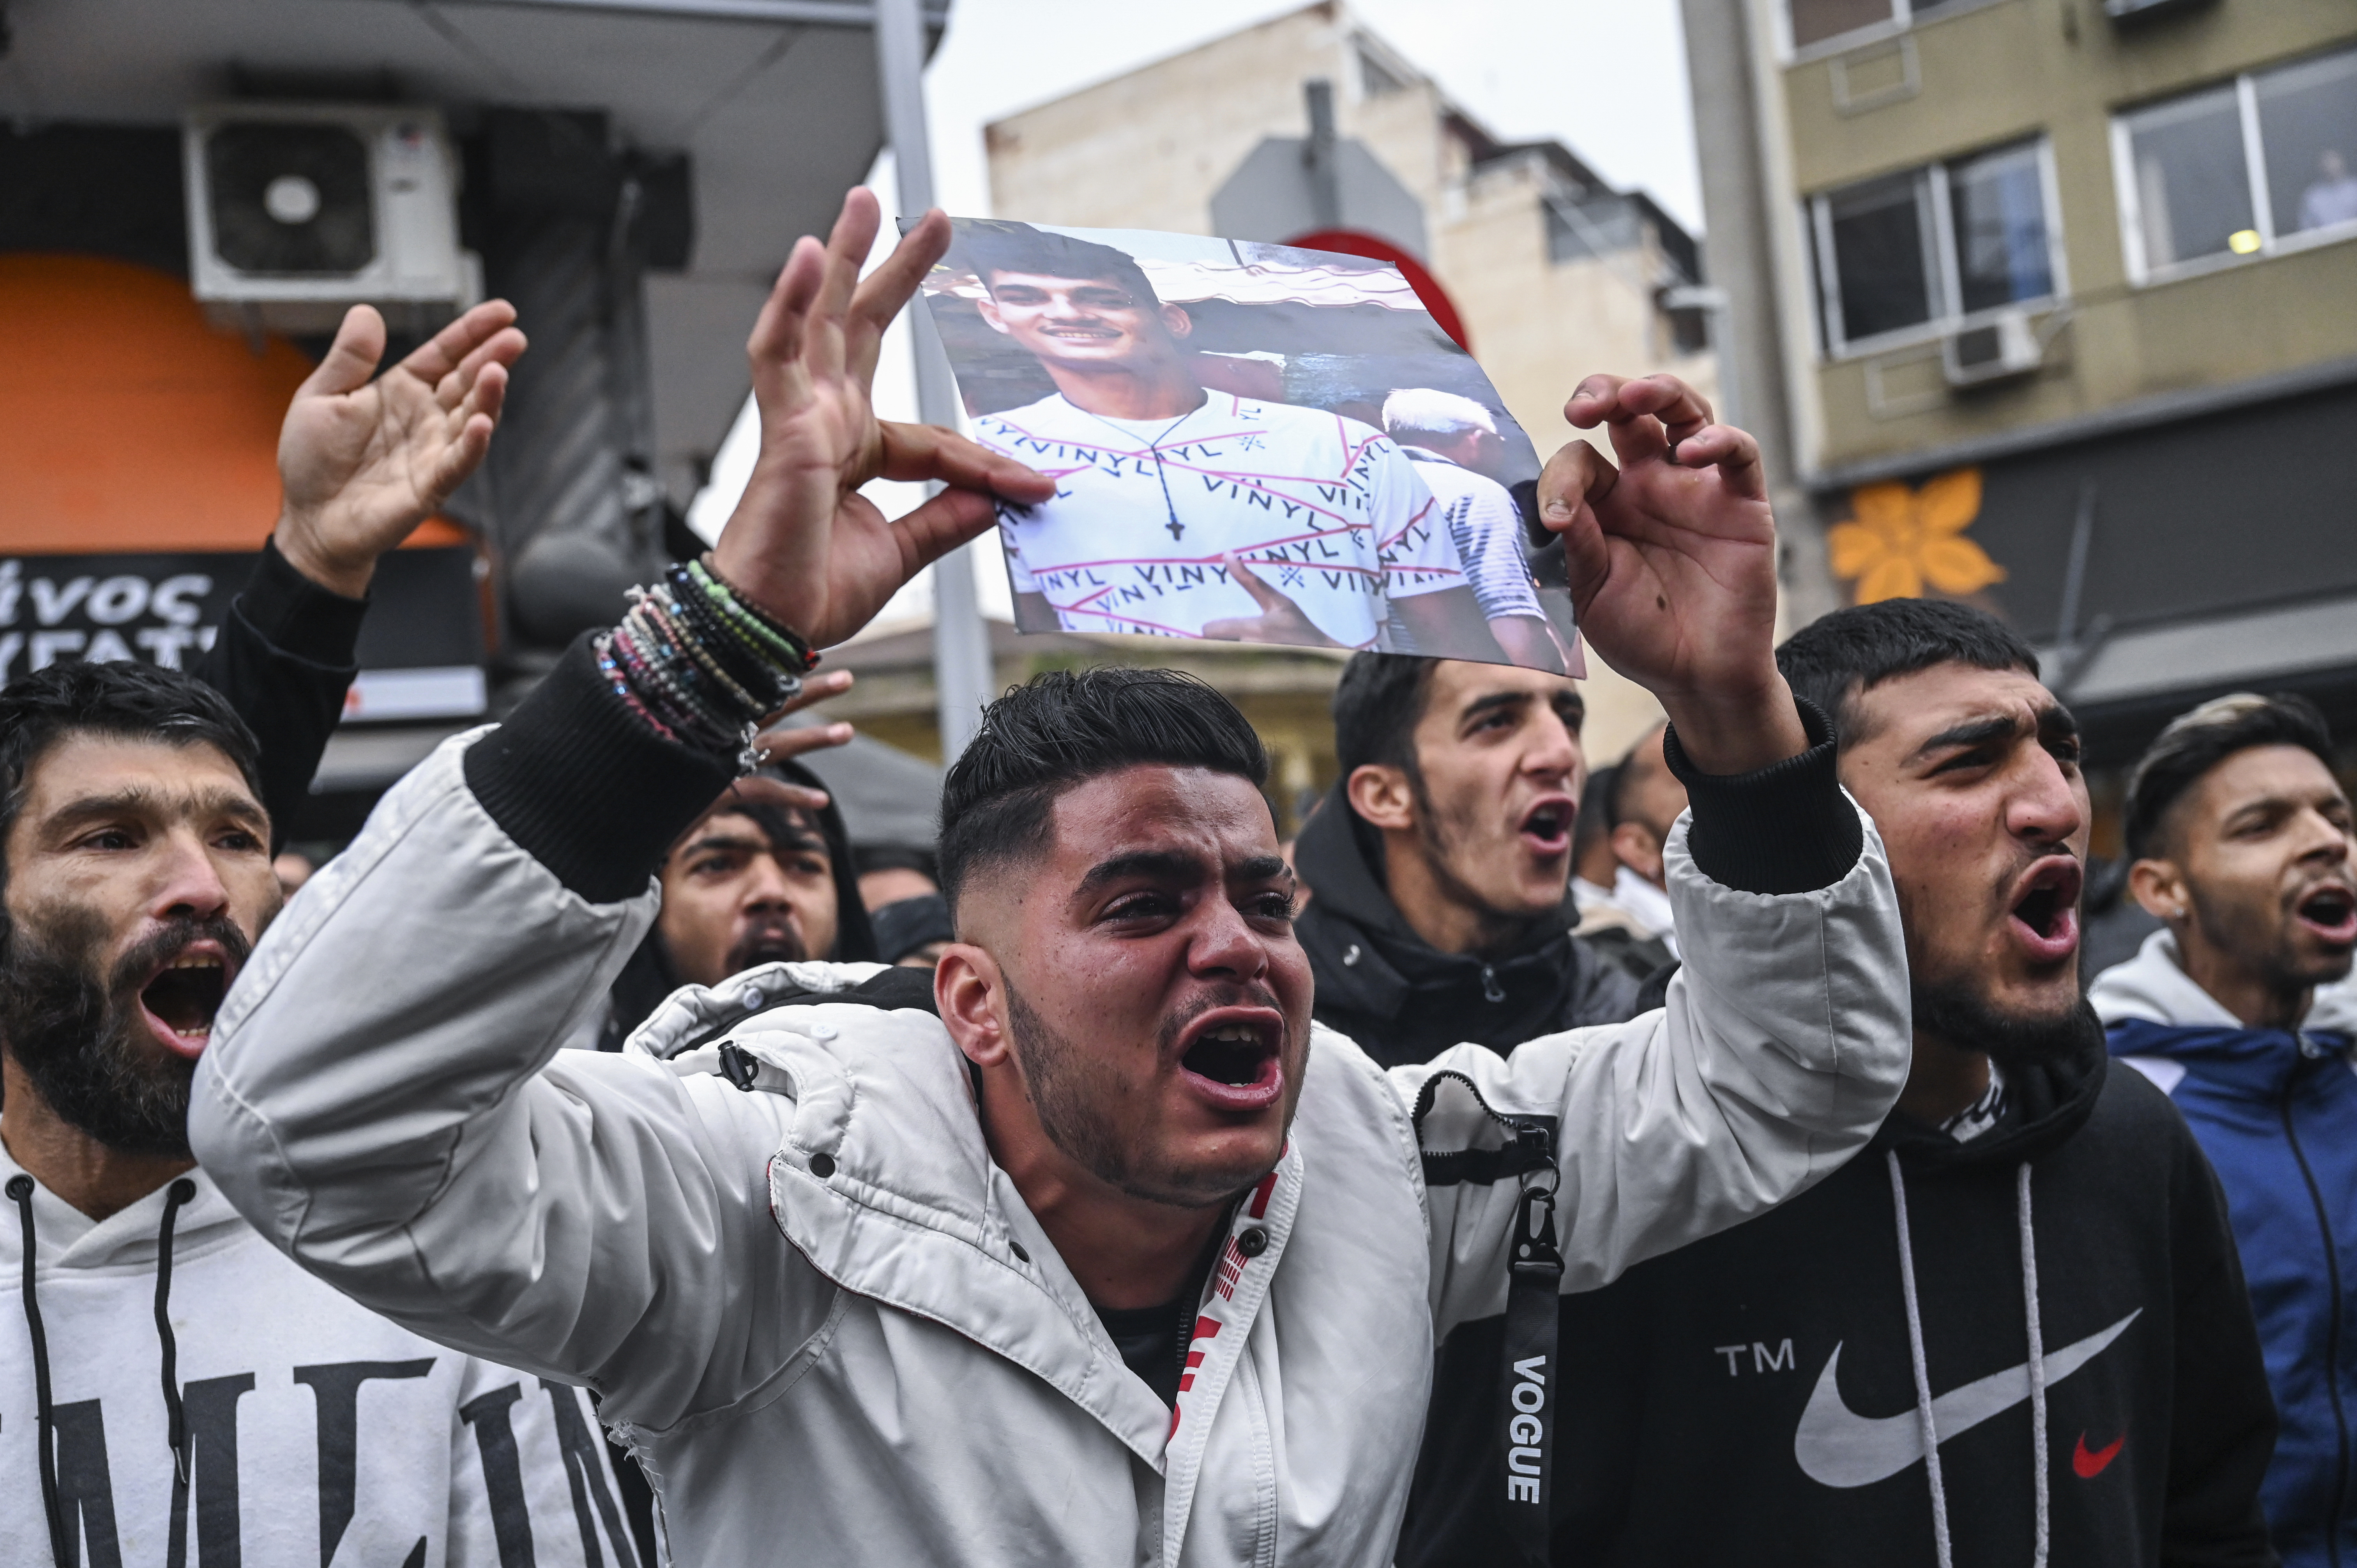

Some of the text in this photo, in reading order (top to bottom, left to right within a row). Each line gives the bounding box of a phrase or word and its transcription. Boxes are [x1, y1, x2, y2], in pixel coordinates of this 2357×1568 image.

[1031, 441, 1154, 477] VINYL
[1202, 474, 1324, 532] VINYL
[1714, 1337, 1795, 1377] TM
[1508, 1355, 1546, 1504] VOGUE
